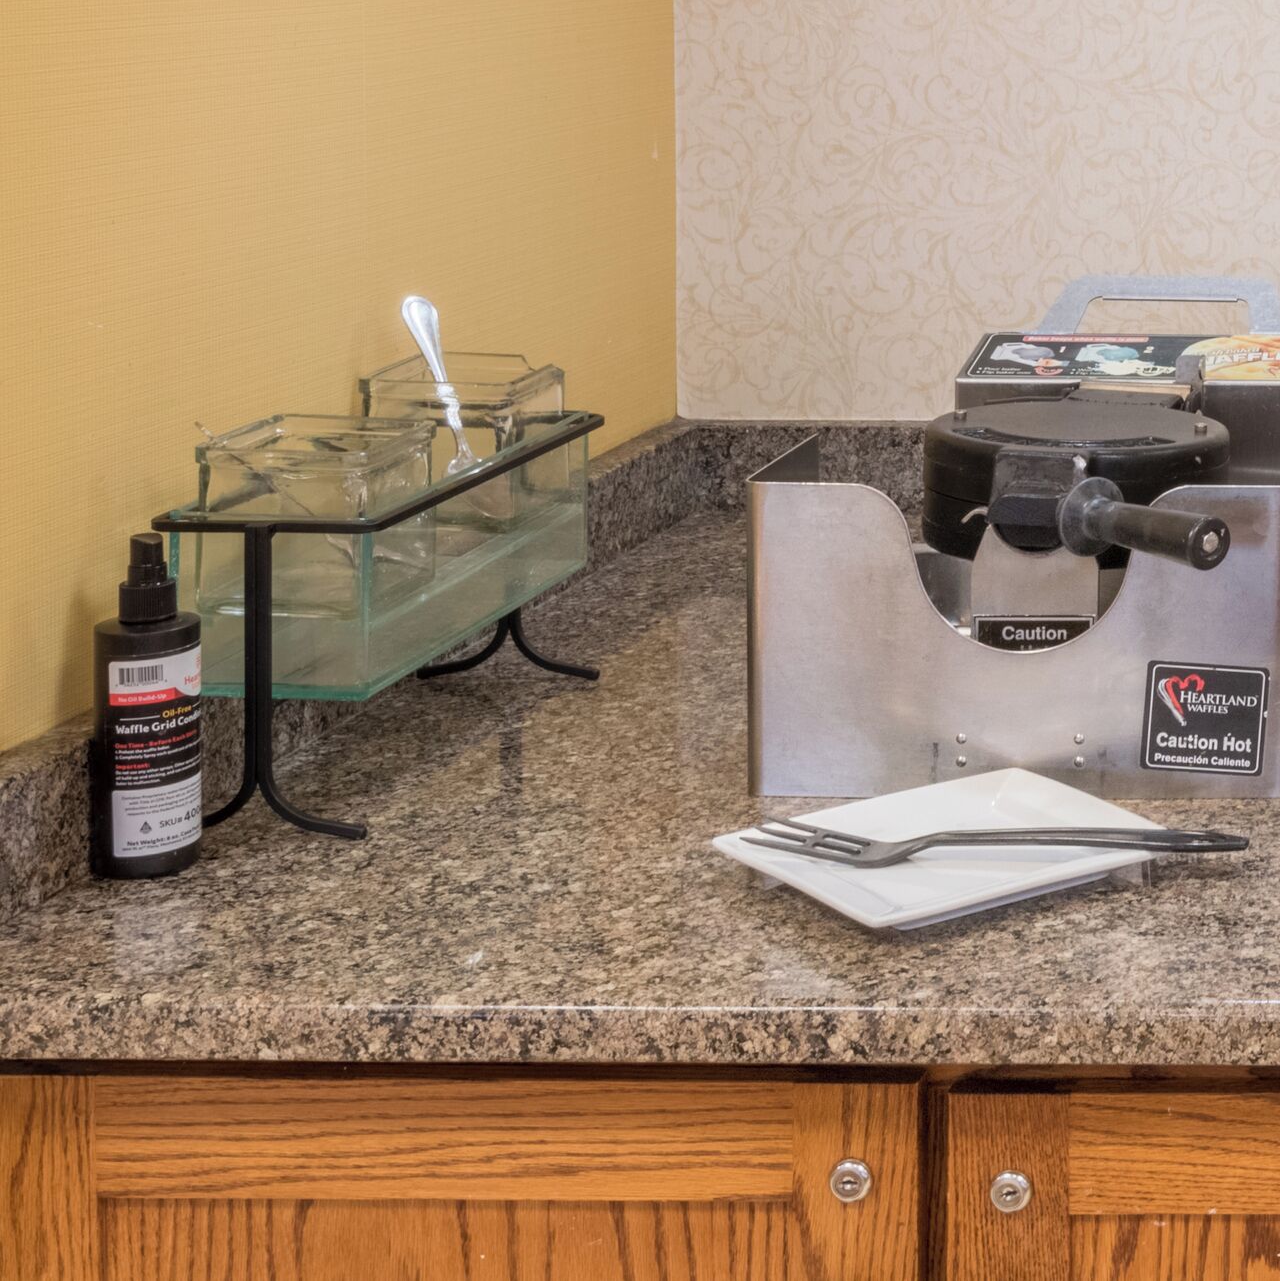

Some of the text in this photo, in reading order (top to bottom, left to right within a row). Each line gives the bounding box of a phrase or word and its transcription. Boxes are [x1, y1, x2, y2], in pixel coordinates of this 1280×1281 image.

[1002, 626, 1067, 640] Caution
[1180, 691, 1258, 707] HEARTLAND
[162, 705, 192, 718] Oil-Free
[1187, 703, 1229, 714] WAFFLES
[115, 724, 150, 734] Waffle
[152, 719, 177, 731] Grid
[1156, 732, 1252, 753] Caution Hot
[1154, 752, 1251, 767] Precaución Caliente
[160, 817, 183, 828] SKU#
[140, 837, 165, 846] Weight:
